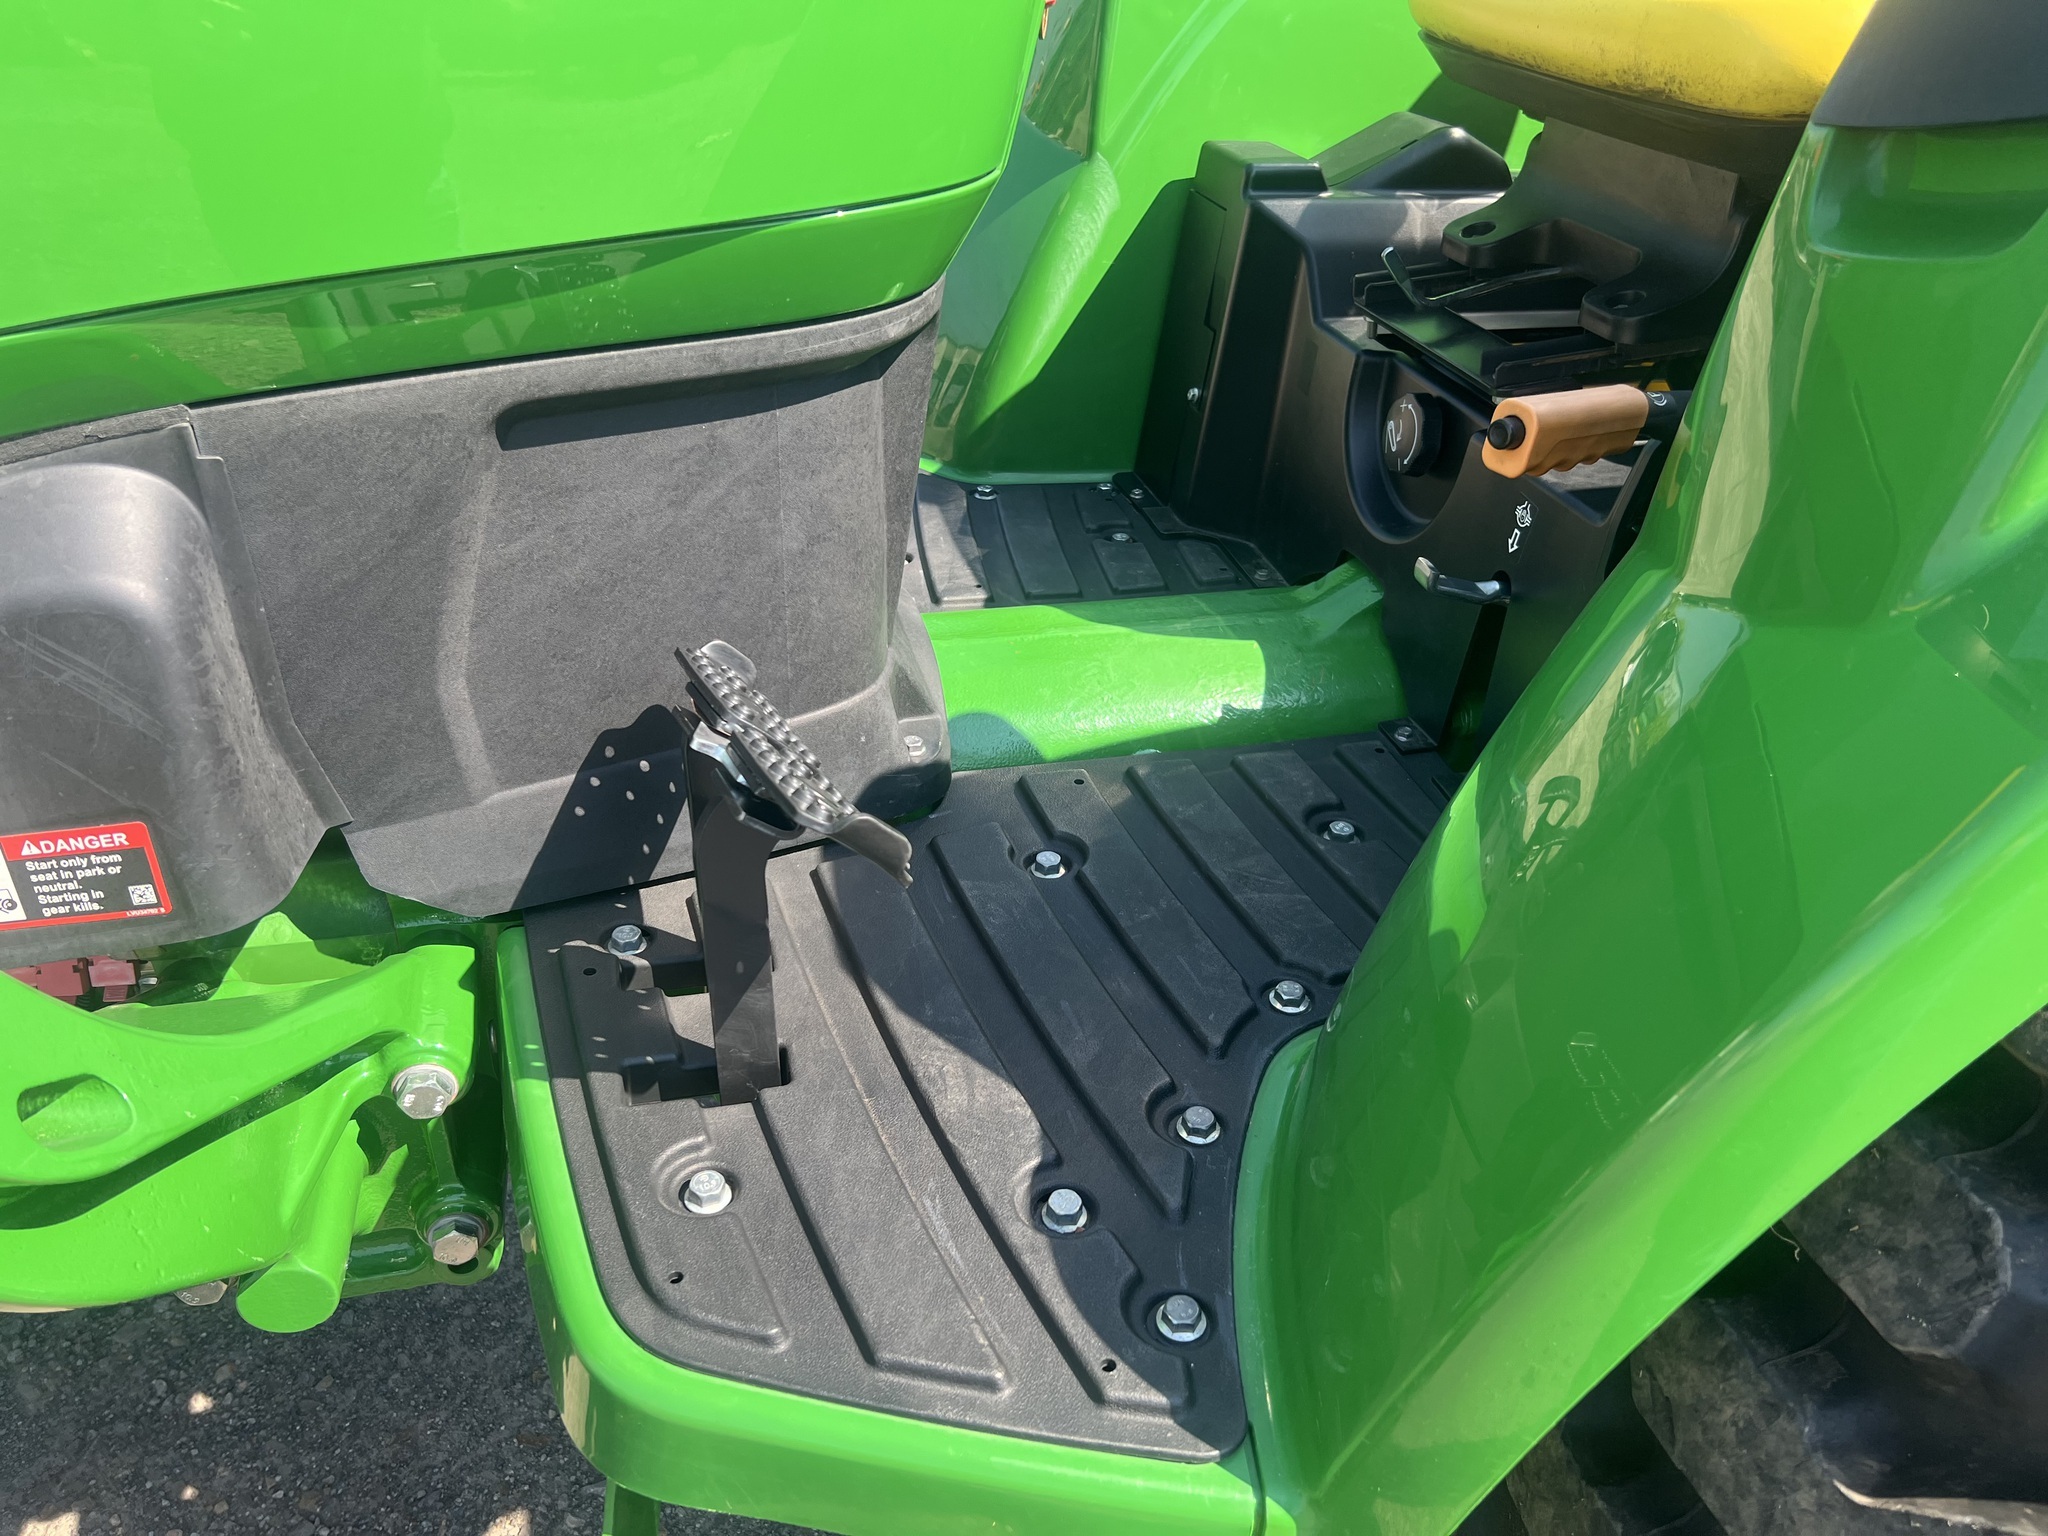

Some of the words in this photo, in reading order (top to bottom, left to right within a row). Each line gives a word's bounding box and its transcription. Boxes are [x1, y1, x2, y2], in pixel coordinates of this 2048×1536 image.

[40, 832, 130, 854] DANGER
[25, 859, 59, 871] Start
[60, 856, 88, 868] only
[90, 854, 122, 865] from
[30, 871, 59, 882] seat
[60, 869, 74, 880] in
[76, 865, 106, 880] park
[107, 865, 122, 875] or
[33, 880, 83, 894] neutral.
[37, 891, 90, 905] Starting
[91, 889, 105, 900] in
[42, 905, 71, 918] gear
[72, 901, 105, 913] kills.
